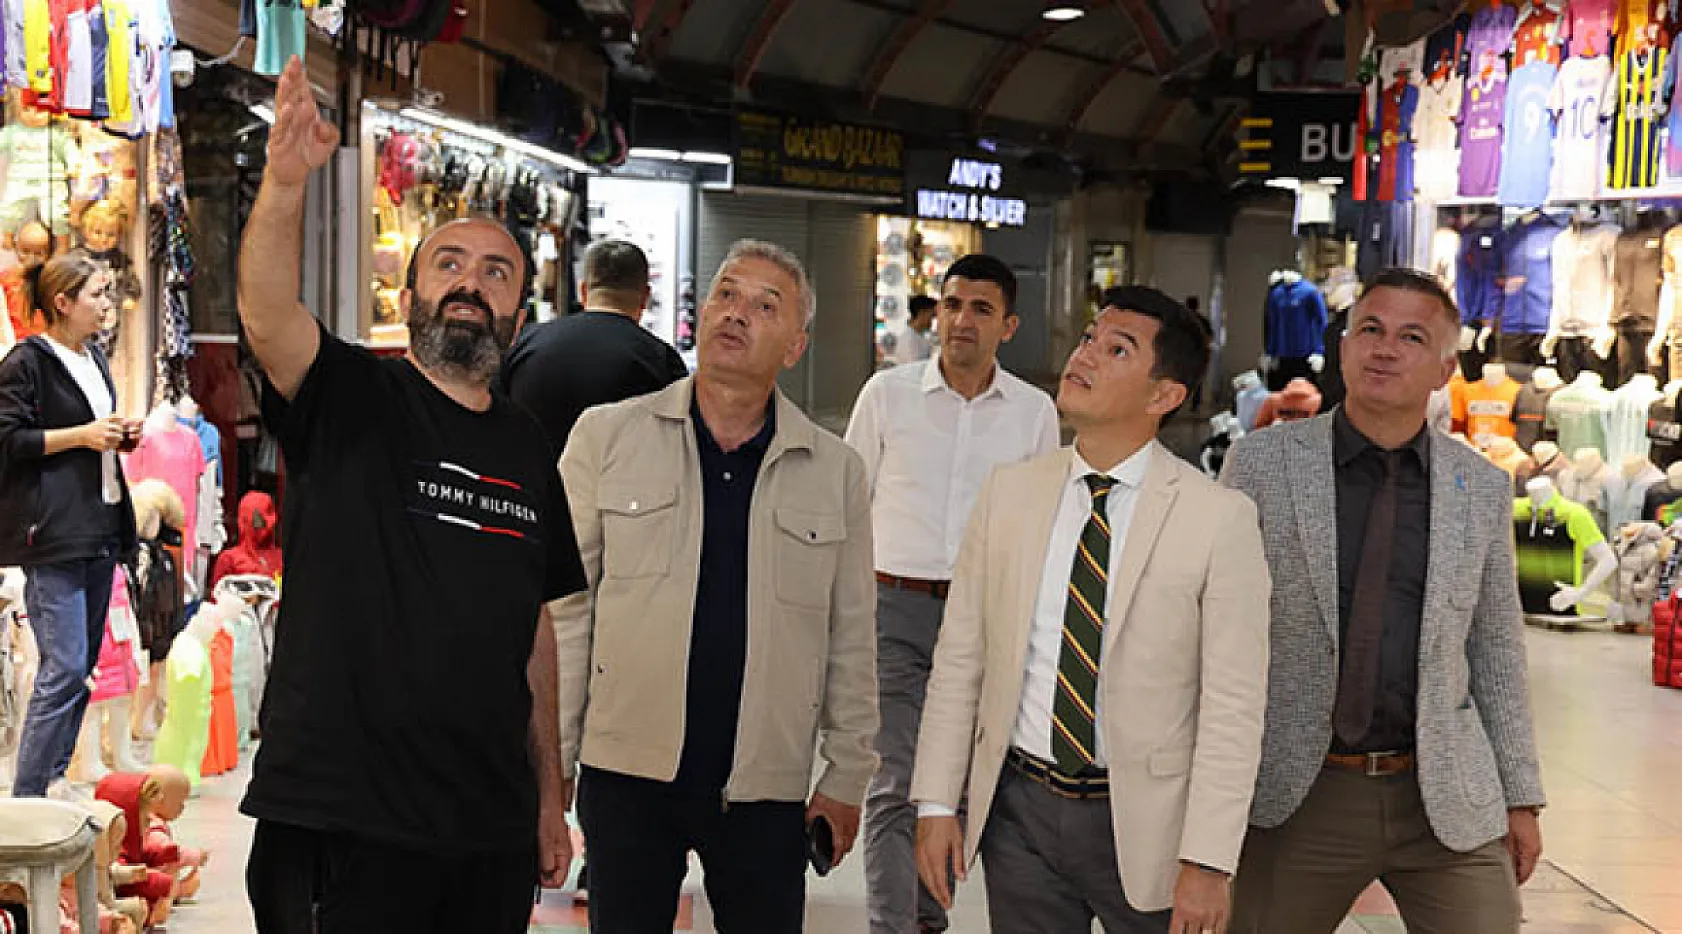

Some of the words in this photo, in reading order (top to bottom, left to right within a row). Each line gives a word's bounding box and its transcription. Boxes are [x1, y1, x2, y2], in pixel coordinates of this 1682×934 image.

[1571, 95, 1597, 140] 10
[917, 189, 967, 219] WATCH
[417, 480, 475, 506] TOMMY
[479, 495, 538, 524] HILFIGER
